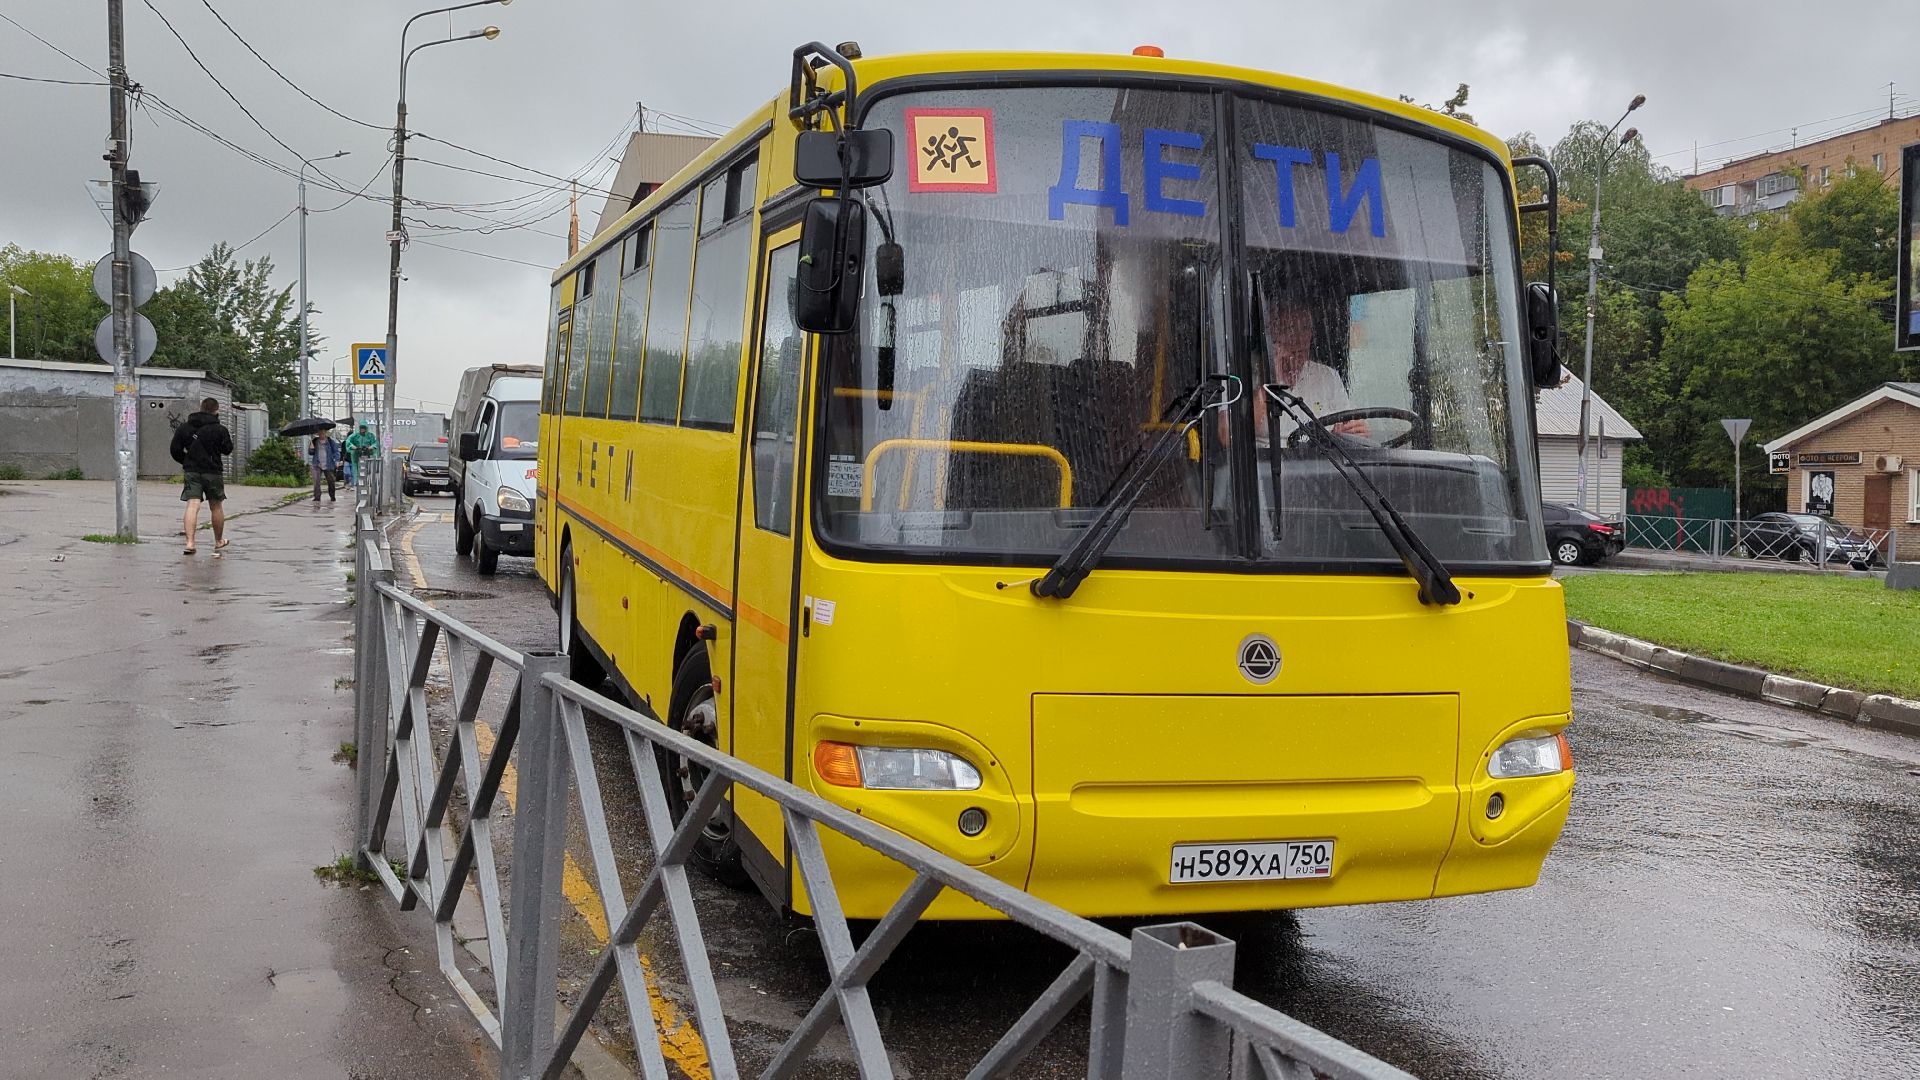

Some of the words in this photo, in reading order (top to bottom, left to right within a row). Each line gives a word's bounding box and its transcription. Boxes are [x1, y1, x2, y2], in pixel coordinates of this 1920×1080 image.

[1048, 119, 1386, 238] ДЕТИ
[576, 439, 634, 504] ДЕТИ
[1800, 454, 1819, 462] ФОТО
[1179, 849, 1282, 878] Н589ХА
[1289, 844, 1326, 867] 750
[1295, 866, 1315, 874] RUS
